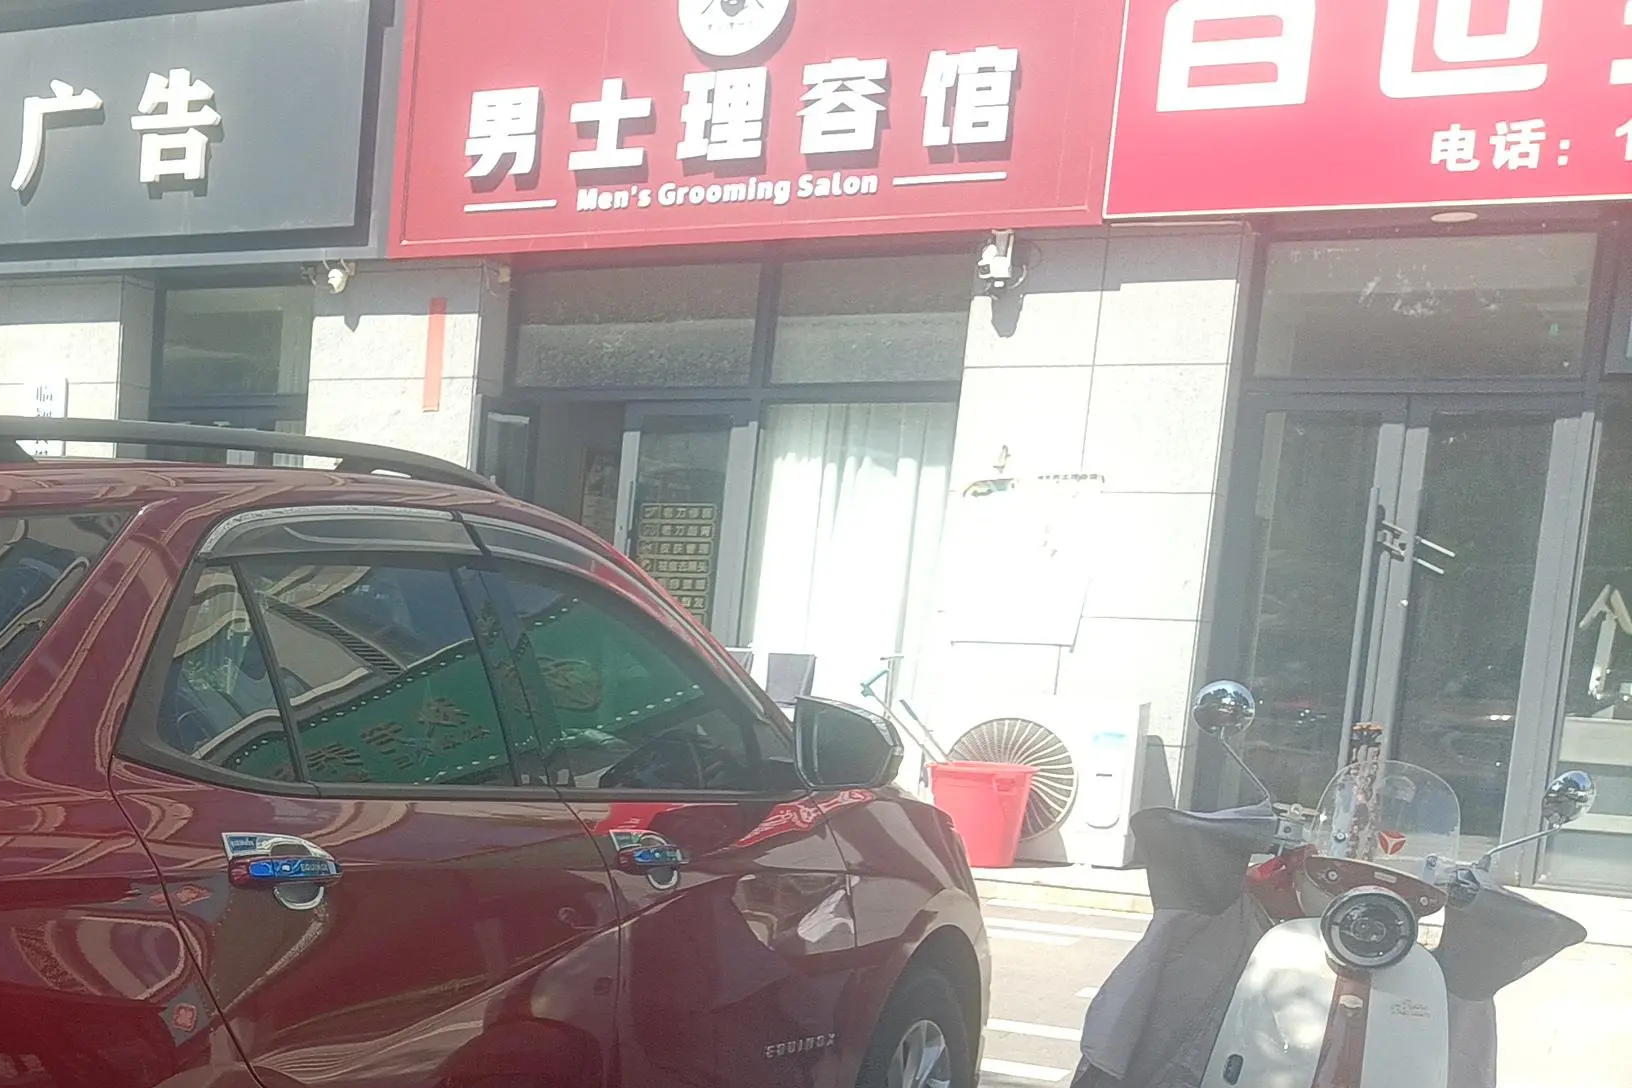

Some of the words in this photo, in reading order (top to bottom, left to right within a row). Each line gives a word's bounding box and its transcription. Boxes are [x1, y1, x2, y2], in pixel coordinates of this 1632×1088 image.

[464, 44, 1019, 179] 男士理容馆
[1156, 0, 1632, 112] 百世
[576, 185, 652, 212] Men's
[657, 176, 791, 206] Grooming
[796, 171, 878, 198] Salon
